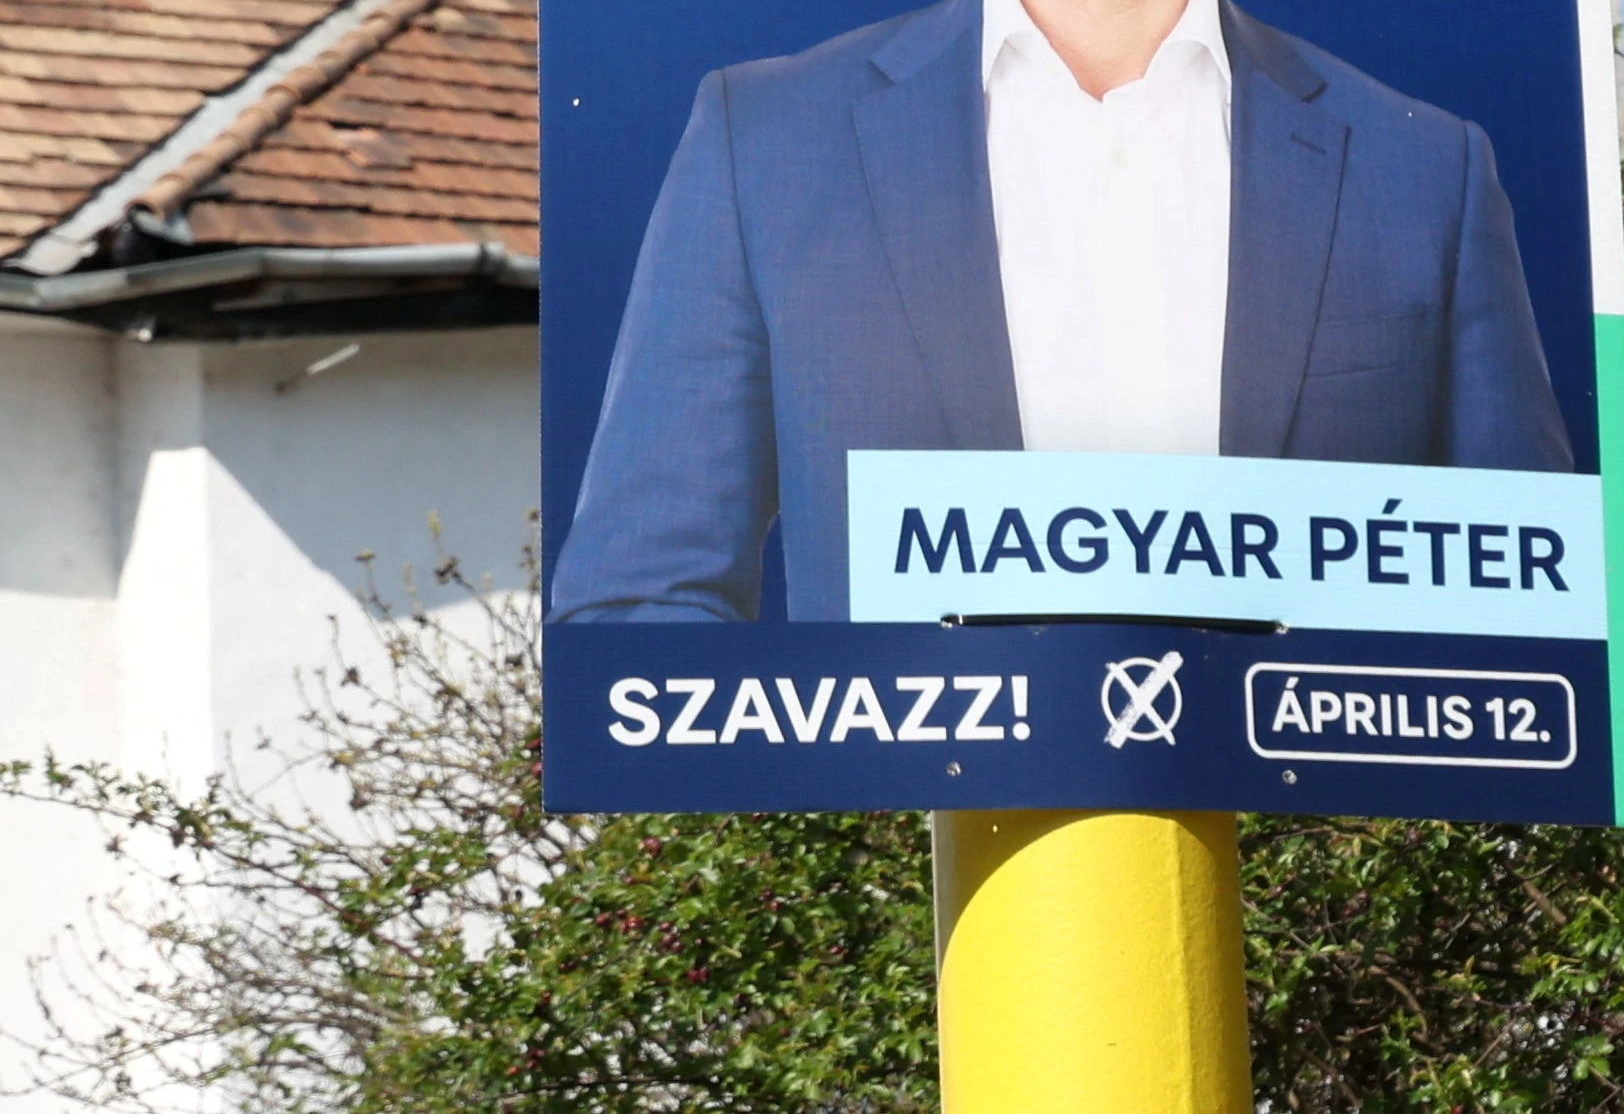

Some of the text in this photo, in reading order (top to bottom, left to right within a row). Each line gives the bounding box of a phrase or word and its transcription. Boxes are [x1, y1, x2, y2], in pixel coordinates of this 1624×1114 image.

[895, 499, 1568, 590] MAGYAR PÉTER
[609, 676, 1030, 745] SZAVAZZ!
[1273, 674, 1550, 742] ÁPRILIS 12.
